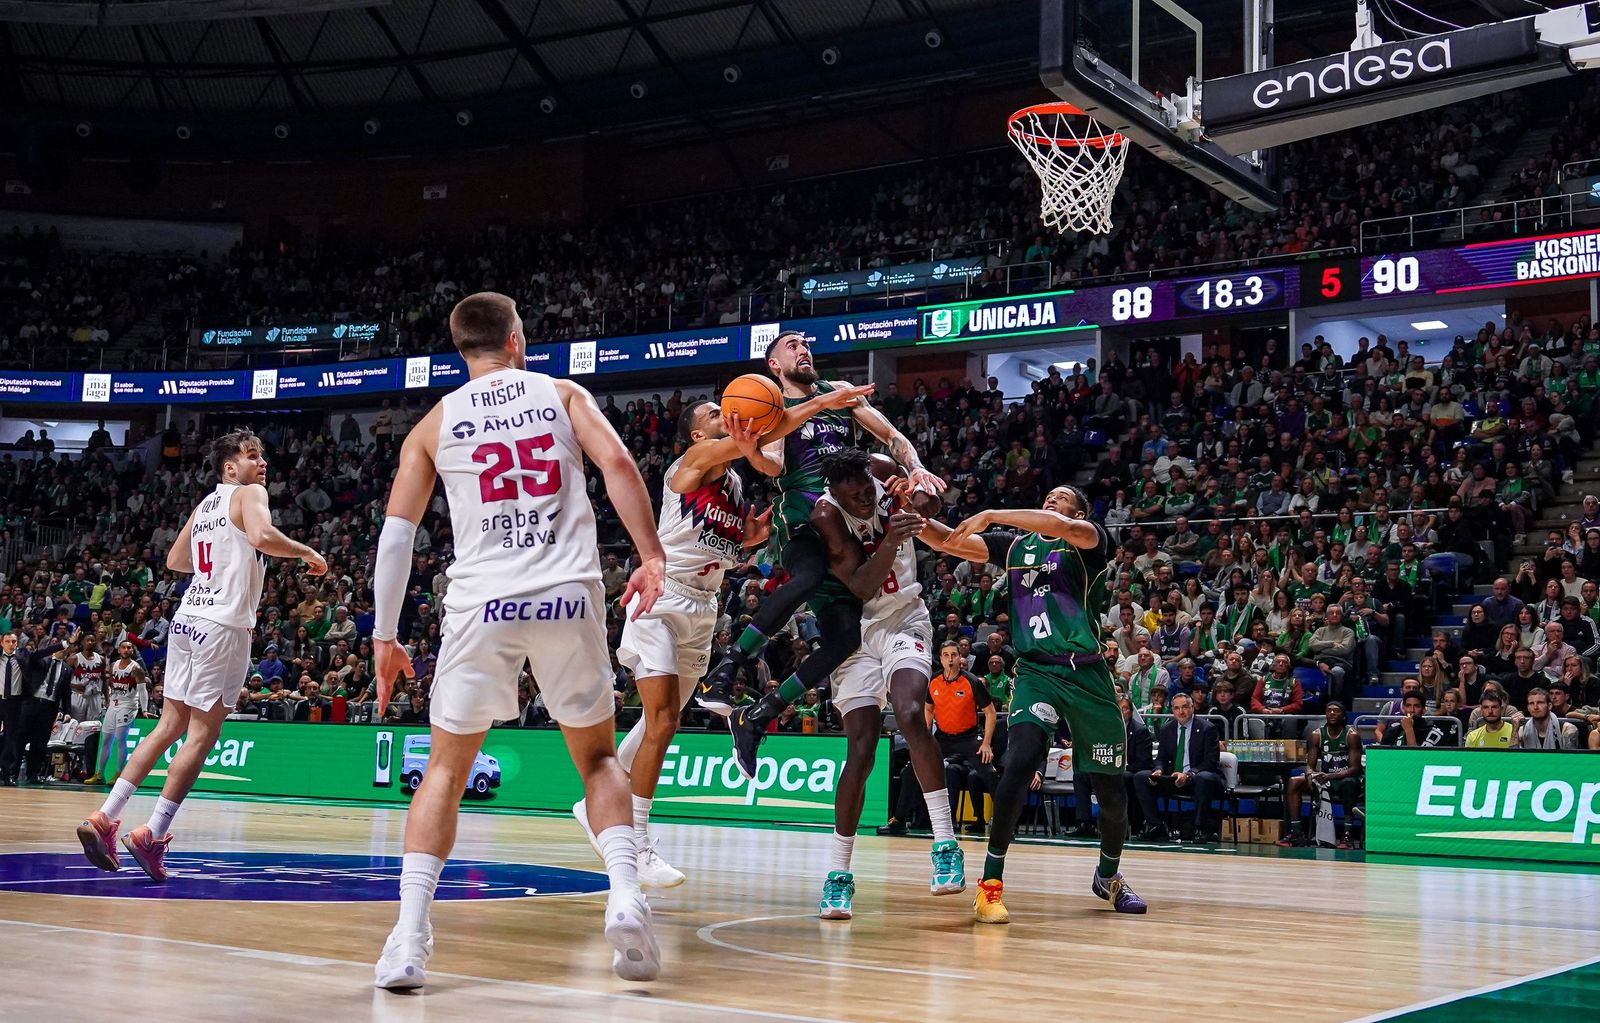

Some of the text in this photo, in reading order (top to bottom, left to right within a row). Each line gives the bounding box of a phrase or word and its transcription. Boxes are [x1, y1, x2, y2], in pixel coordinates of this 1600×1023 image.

[1252, 38, 1452, 110] endesa
[1534, 234, 1600, 259] KOSNE
[1516, 253, 1600, 280] BASKONI
[883, 272, 915, 285] Unicaja
[1320, 267, 1341, 298] 5
[1372, 257, 1419, 294] 90
[817, 280, 848, 292] Unicaja
[1196, 276, 1264, 310] 18.3
[1111, 286, 1153, 321] 88
[968, 301, 1057, 332] UNICAJA
[217, 329, 252, 337] Fundación
[858, 319, 893, 331] Diputación
[217, 337, 242, 345] Unicaja
[867, 329, 892, 339] Málaga
[666, 336, 729, 350] Diputación Provincial
[753, 342, 768, 353] lag
[524, 353, 550, 362] Provincial
[675, 348, 697, 358] Málaga
[336, 368, 388, 378] Diputación Provincial
[572, 359, 592, 371] laga
[8, 386, 30, 394] Málaga
[32, 379, 62, 387] Provincial
[179, 379, 208, 387] Diputación
[86, 388, 107, 399] laga
[470, 381, 526, 408] FRISCH
[483, 407, 557, 433] AMUTIO
[471, 432, 562, 504] 25
[481, 508, 539, 532] araba
[502, 529, 556, 548] álava
[197, 540, 213, 581] 4
[483, 596, 586, 623] Recalvi
[1028, 611, 1053, 640] 21
[1092, 752, 1114, 766] laga
[656, 744, 849, 806] Europca
